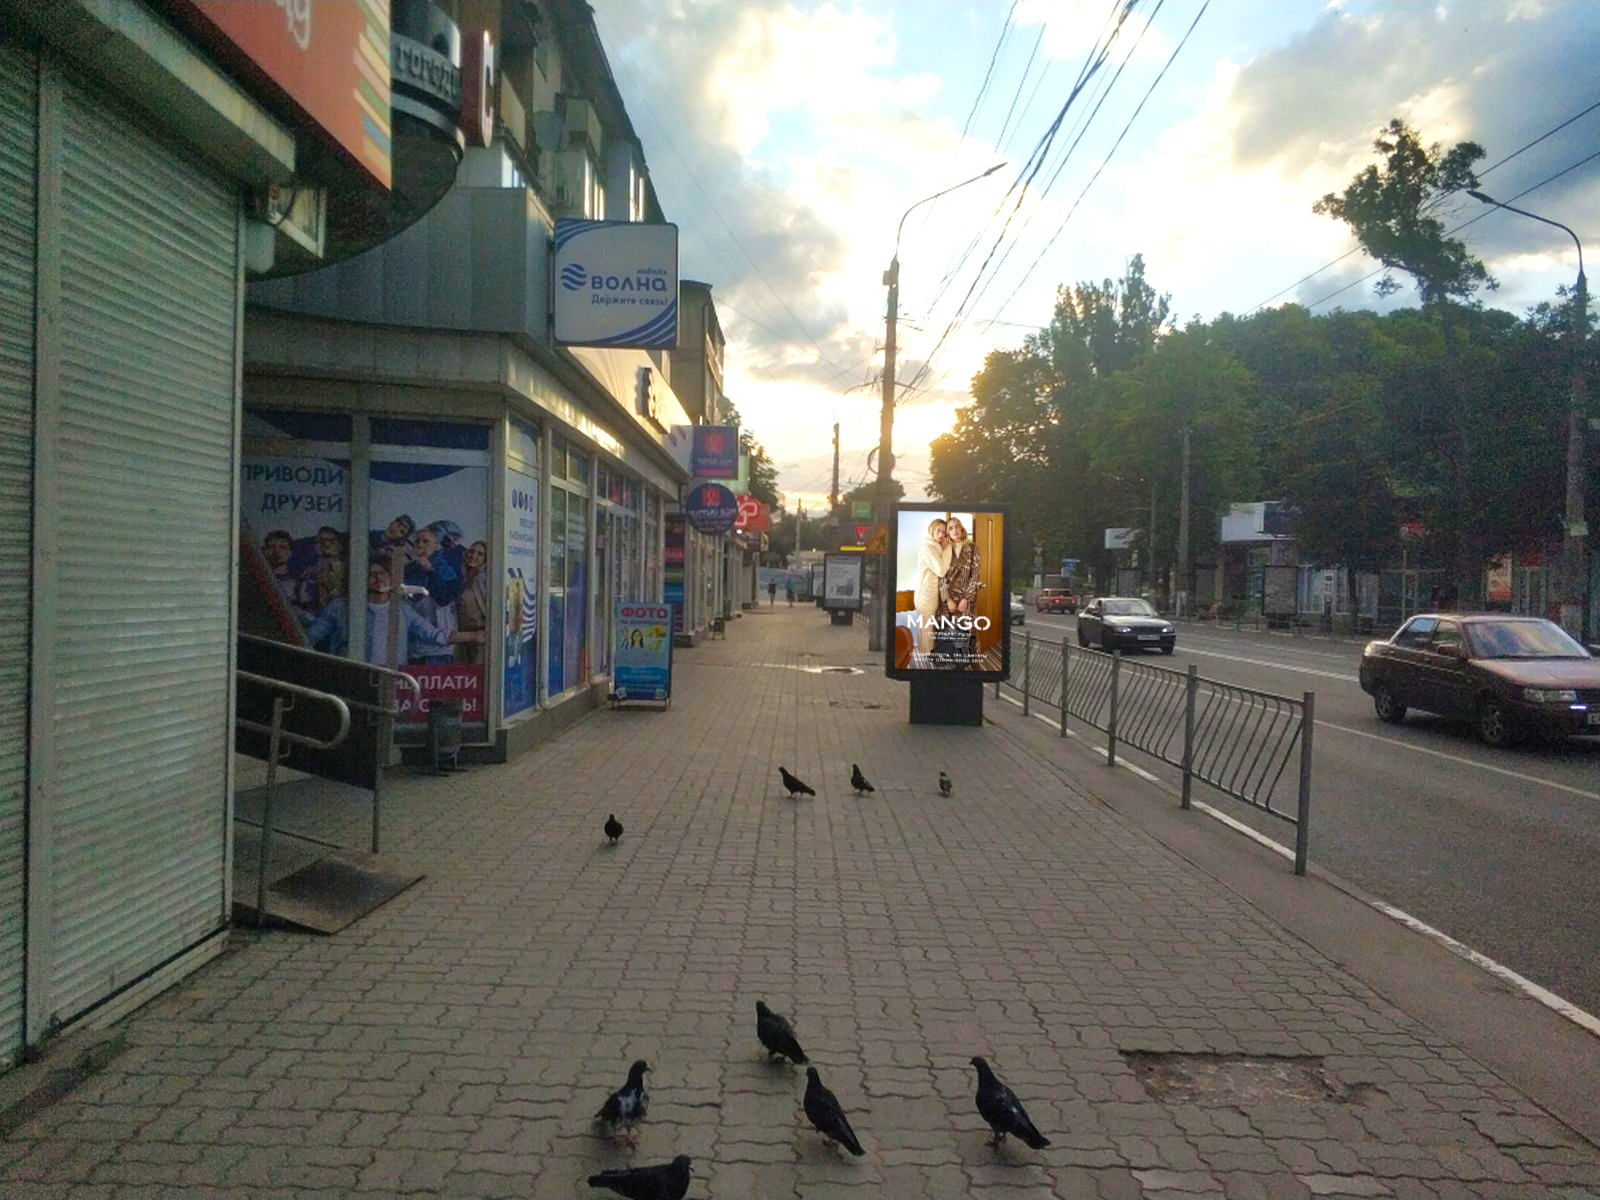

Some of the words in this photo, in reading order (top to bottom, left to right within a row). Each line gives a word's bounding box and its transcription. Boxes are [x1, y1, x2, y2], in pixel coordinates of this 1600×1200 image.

[260, 492, 344, 514] ДРУЗЕЙ
[621, 606, 669, 619] ФОТО
[907, 614, 991, 631] MANGO
[417, 675, 478, 690] ПЛАТИ
[418, 697, 478, 713] СЬ!
